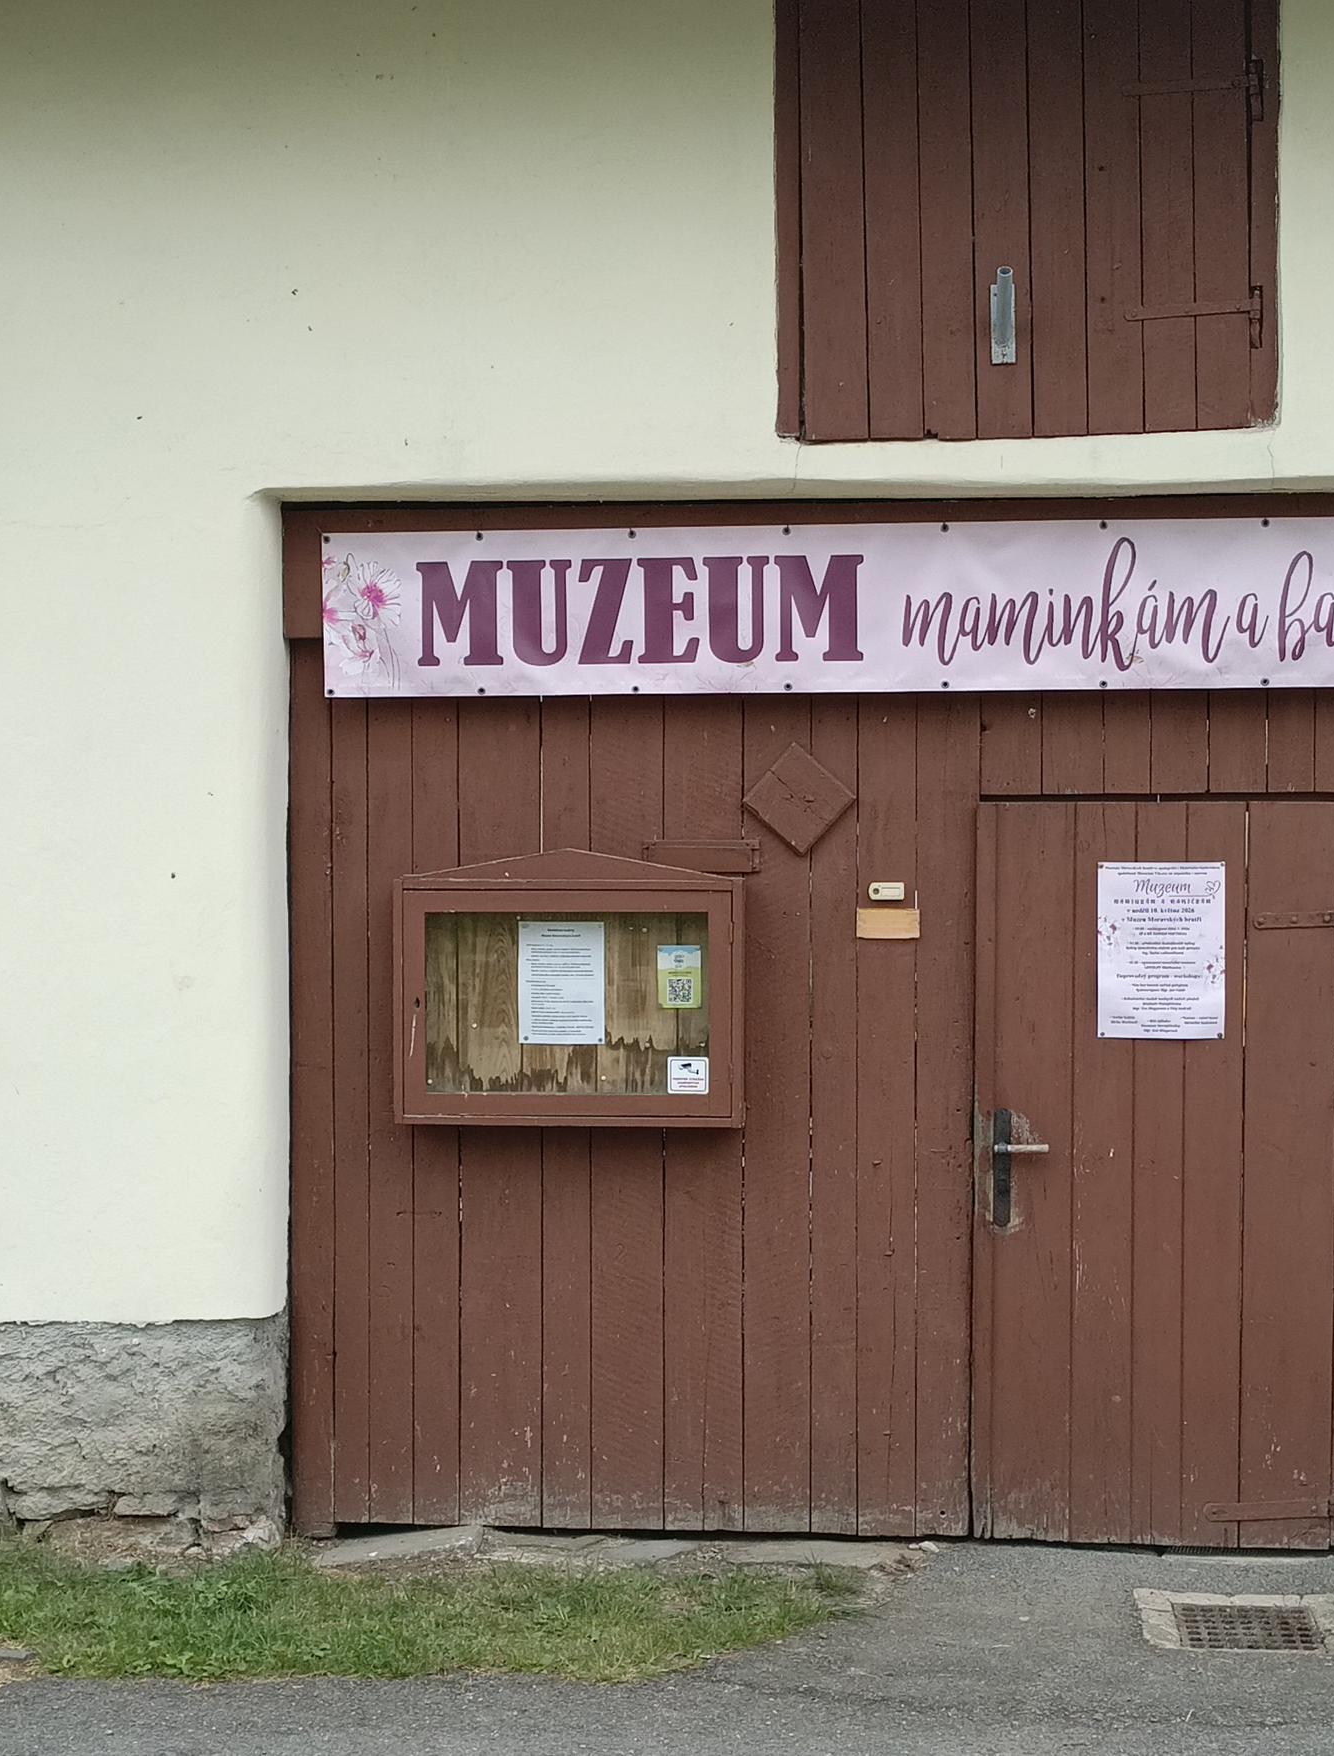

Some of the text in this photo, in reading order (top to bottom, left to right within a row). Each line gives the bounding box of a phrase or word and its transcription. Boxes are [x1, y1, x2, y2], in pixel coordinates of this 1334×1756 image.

[415, 554, 864, 667] MUZEUM
[902, 537, 1231, 671] maminkám
[1236, 592, 1267, 650] a
[1133, 879, 1191, 897] Muzeum
